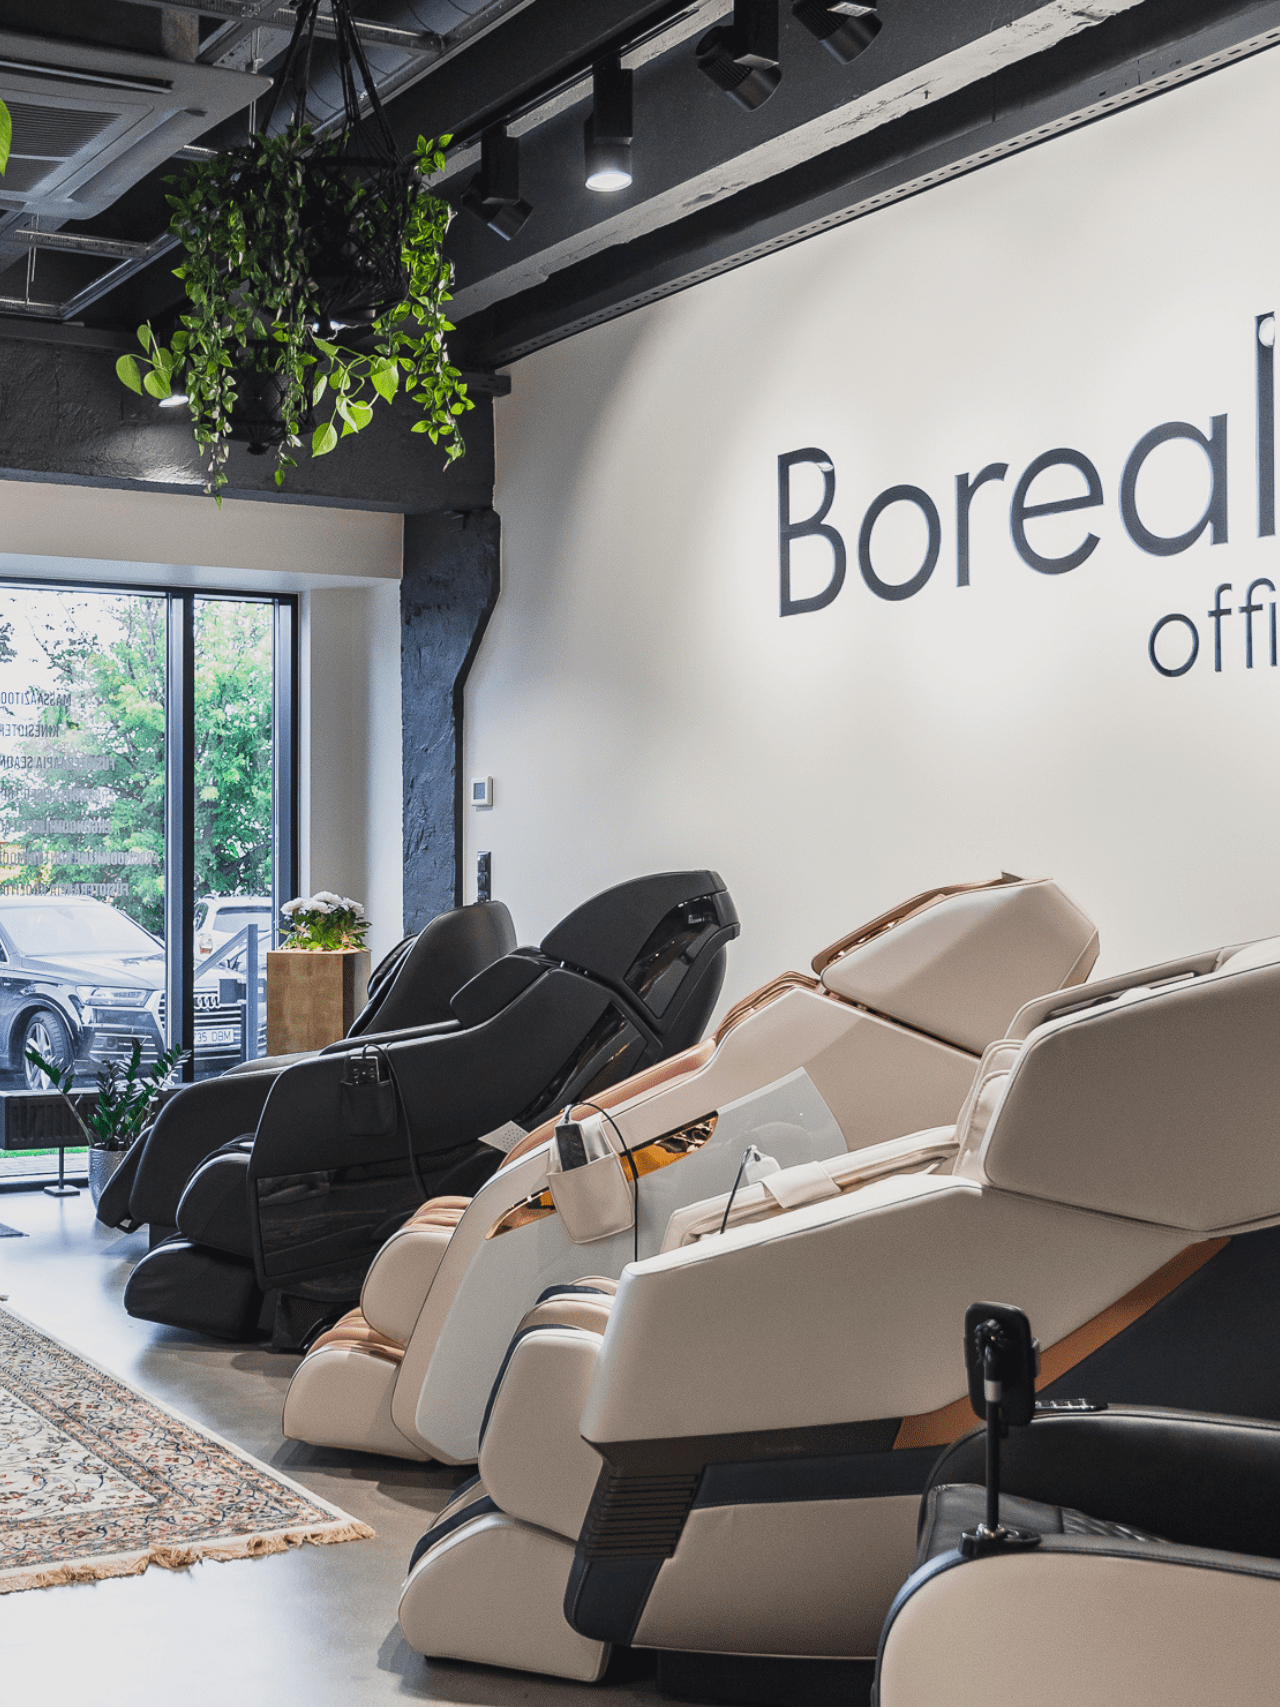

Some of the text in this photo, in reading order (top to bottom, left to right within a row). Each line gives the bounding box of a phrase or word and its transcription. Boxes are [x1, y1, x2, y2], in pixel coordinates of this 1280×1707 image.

[777, 311, 1276, 618] Boreal
[1147, 577, 1278, 678] offi
[194, 1031, 208, 1042] 35
